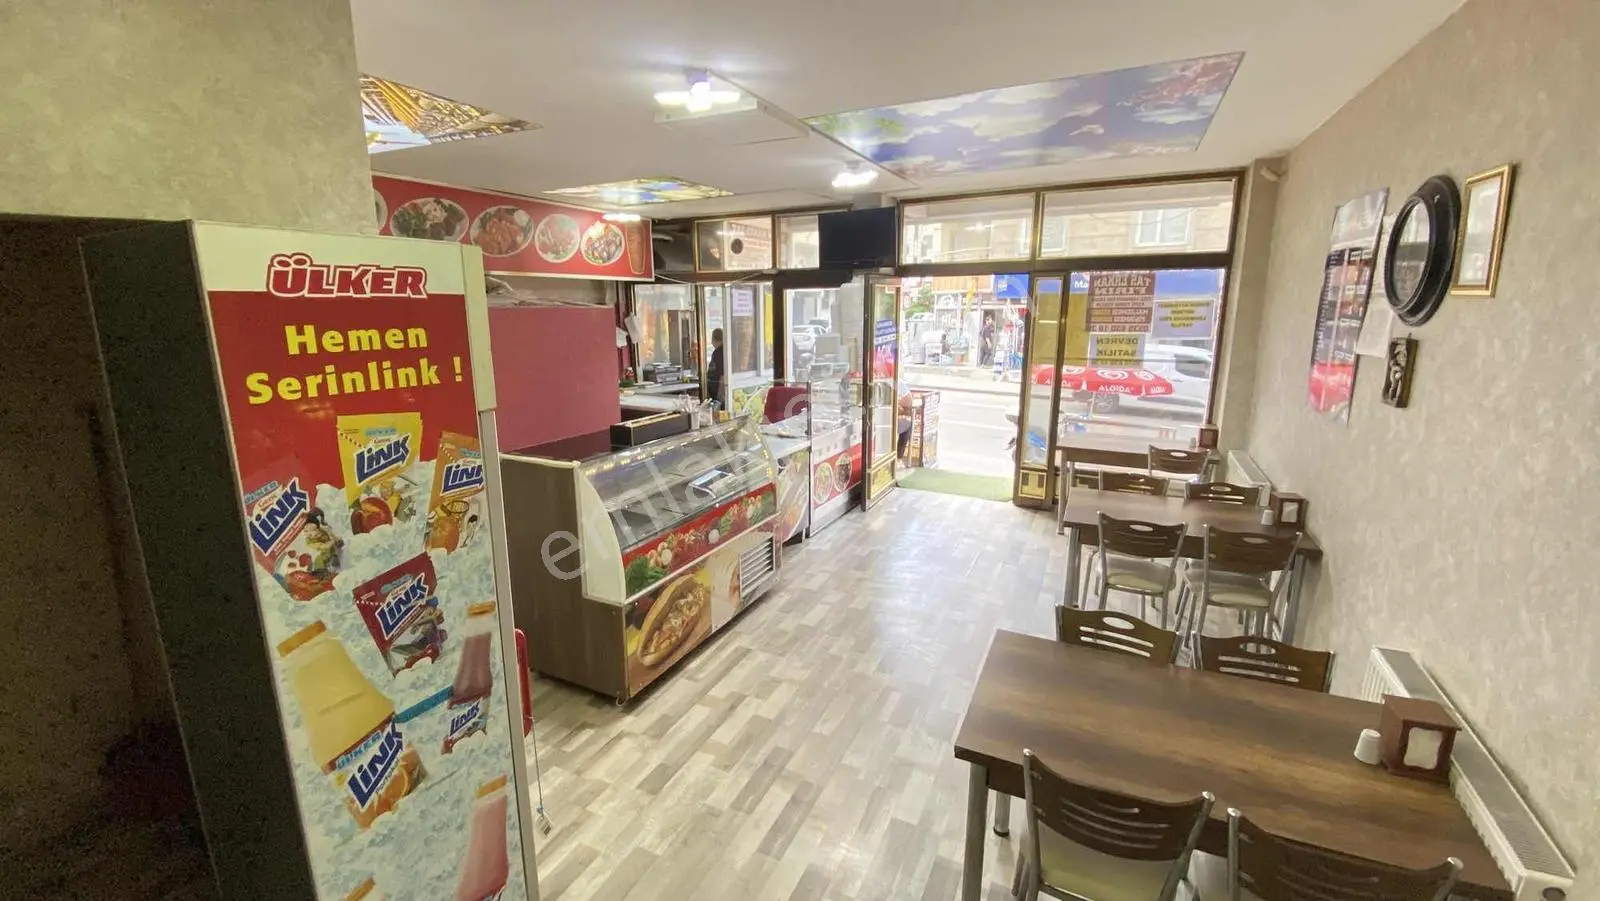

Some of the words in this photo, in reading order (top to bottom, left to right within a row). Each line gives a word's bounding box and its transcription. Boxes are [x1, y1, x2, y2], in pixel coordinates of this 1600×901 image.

[266, 253, 427, 298] ÜLKER
[284, 324, 428, 355] Hemen
[246, 358, 440, 405] Serinlink
